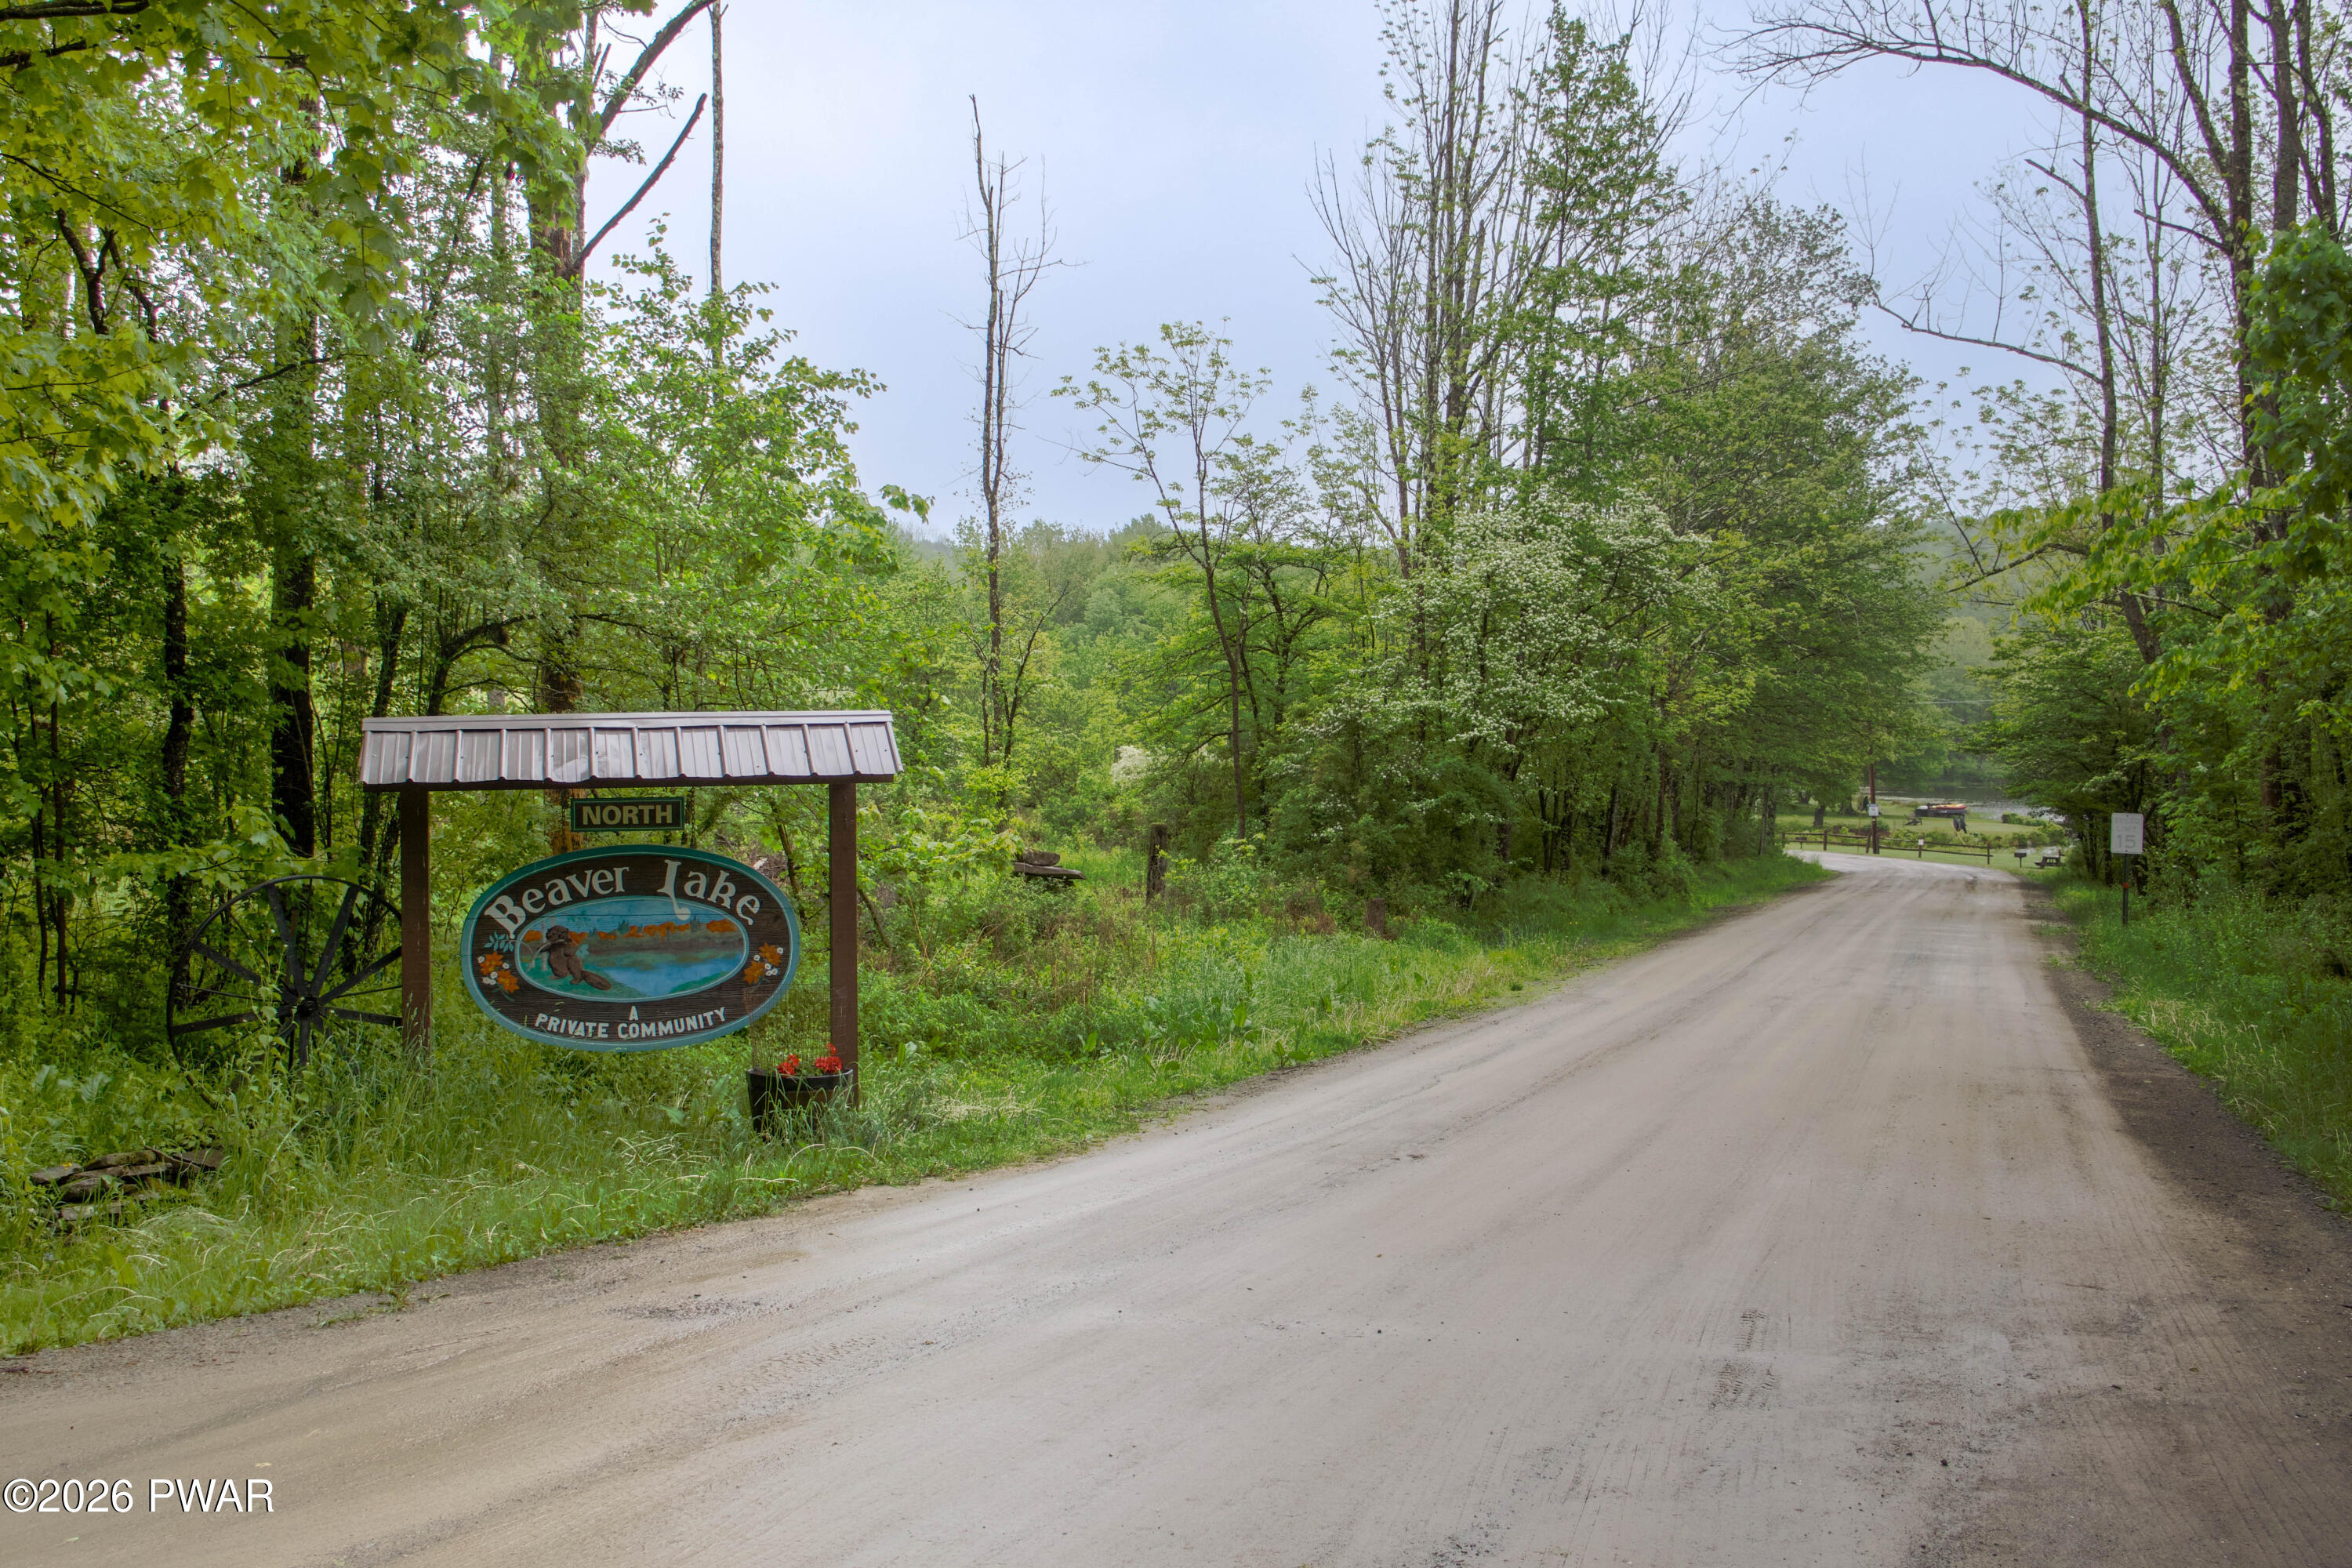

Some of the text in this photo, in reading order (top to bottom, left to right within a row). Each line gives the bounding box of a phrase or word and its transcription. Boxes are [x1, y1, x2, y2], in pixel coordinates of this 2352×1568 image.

[582, 804, 673, 826] NORTH
[2117, 835, 2136, 848] 15
[484, 859, 761, 939] Beaver Lake
[535, 1007, 726, 1039] PRIVATE COMMUNITY
[629, 1005, 640, 1021] A
